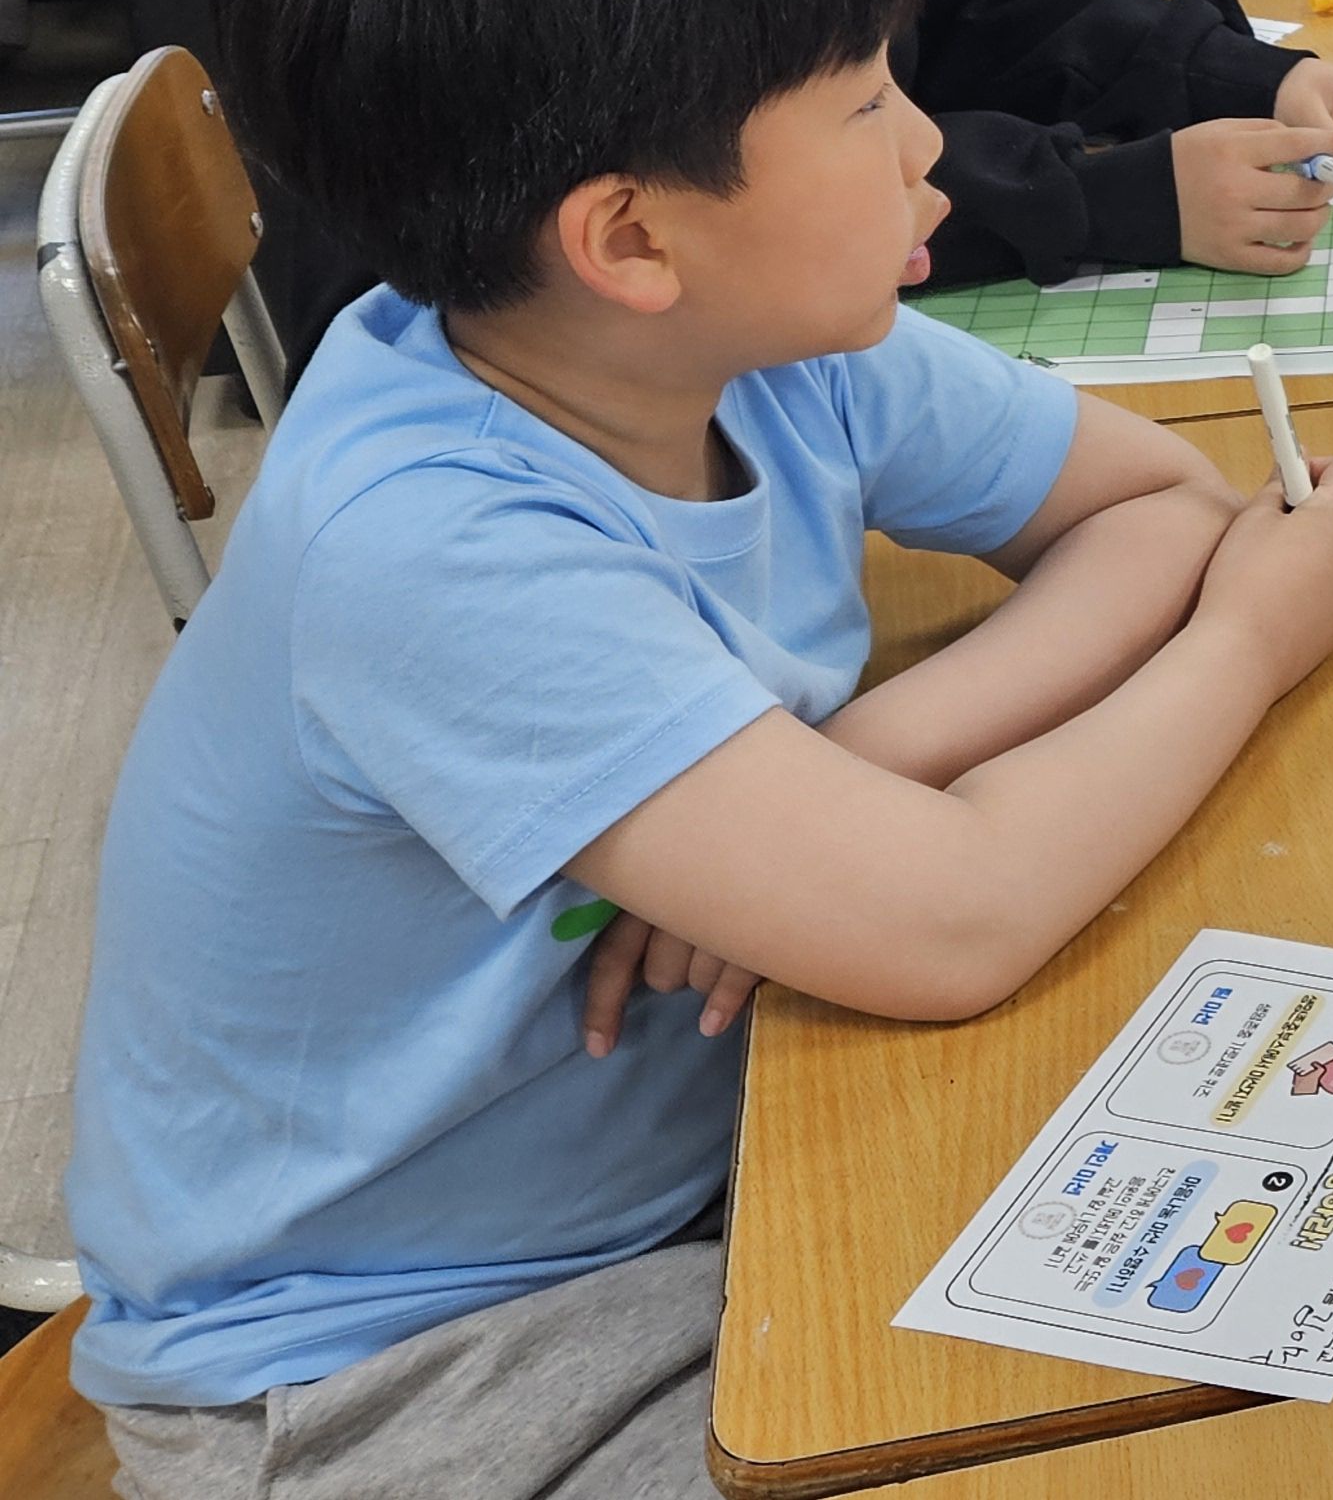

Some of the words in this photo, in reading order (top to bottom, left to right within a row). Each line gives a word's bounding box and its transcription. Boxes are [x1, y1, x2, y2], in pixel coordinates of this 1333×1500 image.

[1209, 986, 1234, 999] 팀
[1188, 1000, 1224, 1025] 미션
[1234, 1003, 1273, 1039] 생명존중
[1252, 994, 1320, 1069] 생명존중부스에서
[1205, 1040, 1246, 1077] 가로세로
[1190, 1078, 1218, 1098] 퀴즈
[1231, 1069, 1266, 1099] 미션지
[1213, 1099, 1245, 1123] 받기
[1082, 1139, 1119, 1167] 개인
[1060, 1167, 1097, 1195] 미션
[1095, 1177, 1123, 1197] 교실
[1111, 1175, 1147, 1206] 응원의
[1133, 1167, 1176, 1208] 친구에게
[1085, 1199, 1106, 1211] 앞
[1156, 1175, 1202, 1220] 마음나눔
[1060, 1211, 1097, 1244] 나무에
[1116, 1208, 1146, 1231] 하고
[1099, 1232, 1129, 1255] 싶은
[1138, 1220, 1170, 1245] 미션
[1041, 1245, 1072, 1268] 걸기
[1059, 1250, 1091, 1276] 쓰고
[1089, 1255, 1112, 1268] 말
[1103, 1245, 1153, 1293] 수행하기
[1071, 1268, 1102, 1293] 또는
